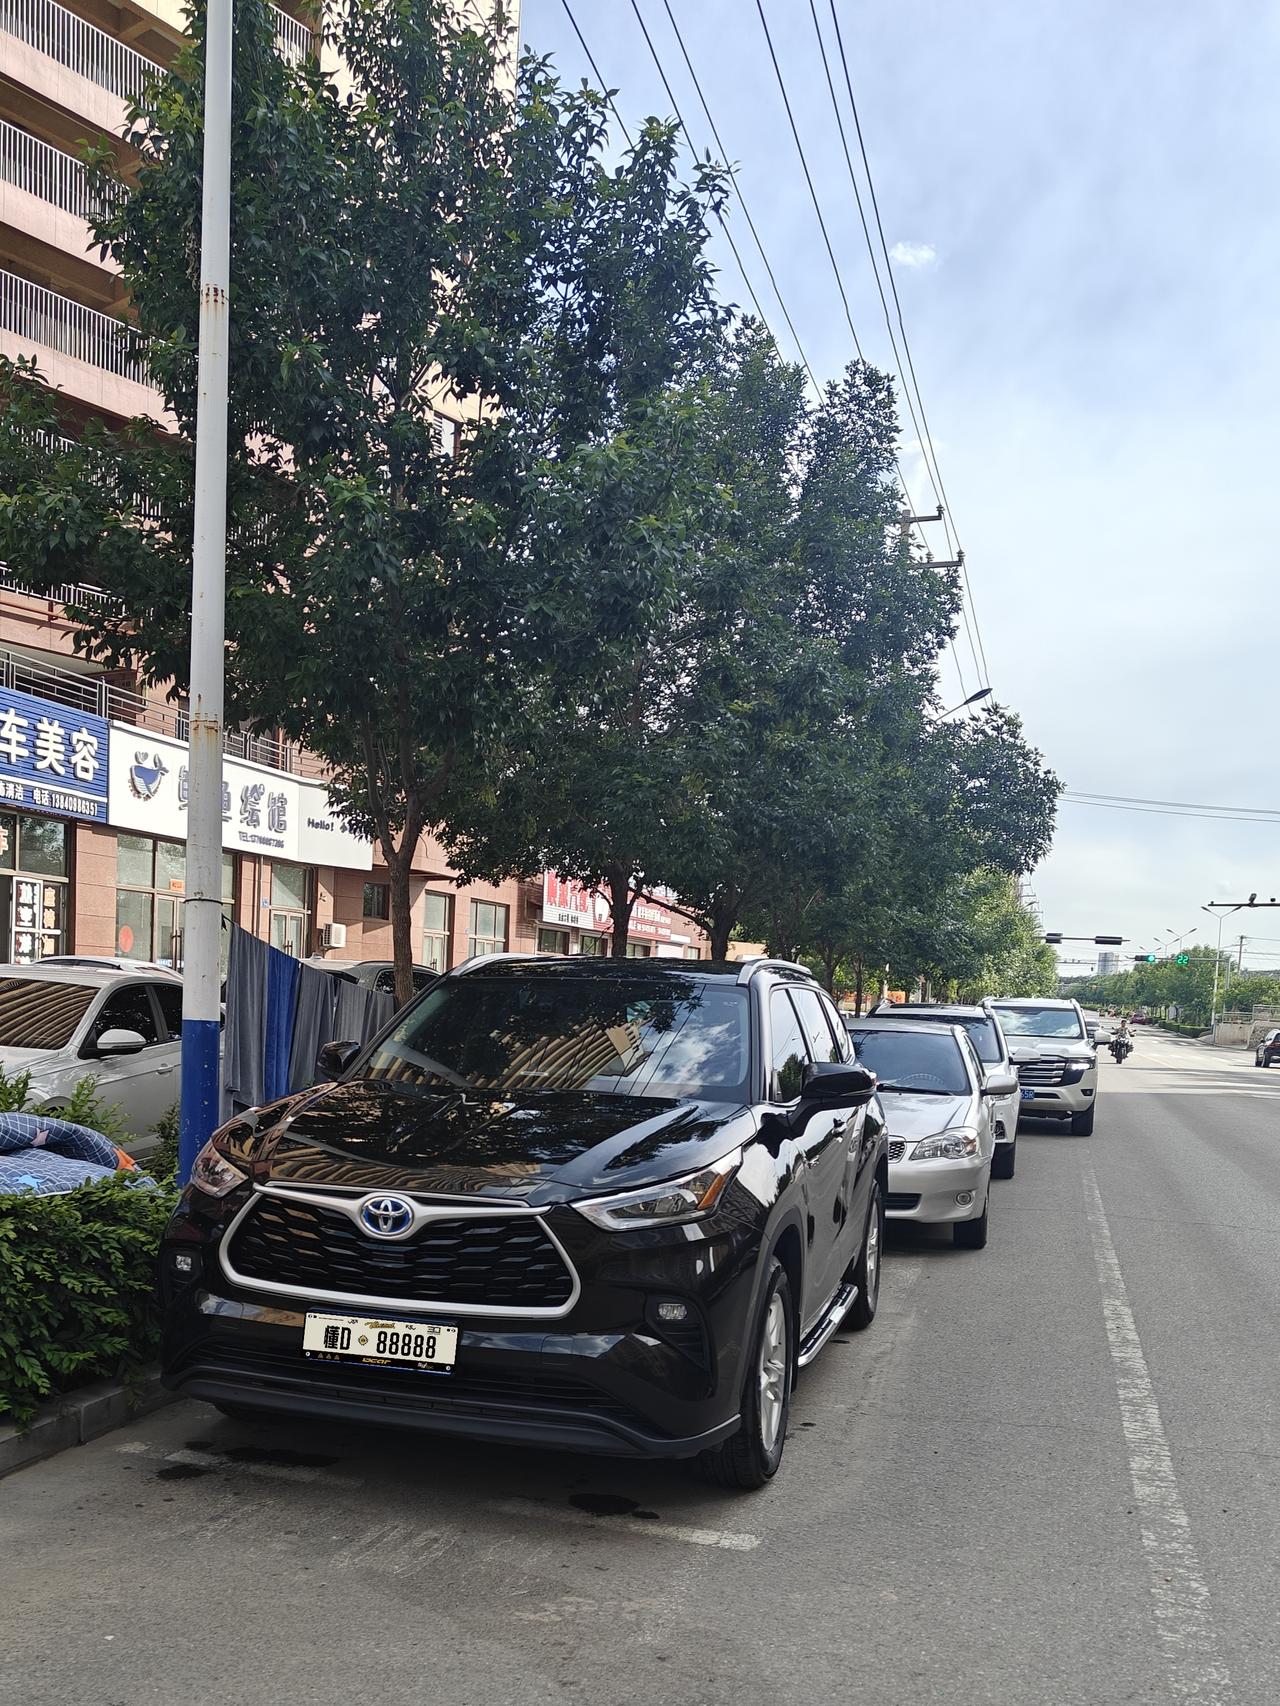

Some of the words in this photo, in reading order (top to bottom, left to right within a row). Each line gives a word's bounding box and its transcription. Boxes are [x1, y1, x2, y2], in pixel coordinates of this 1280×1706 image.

[0, 707, 100, 781] 车美容
[307, 818, 335, 832] Hello!
[1177, 955, 1189, 964] 22
